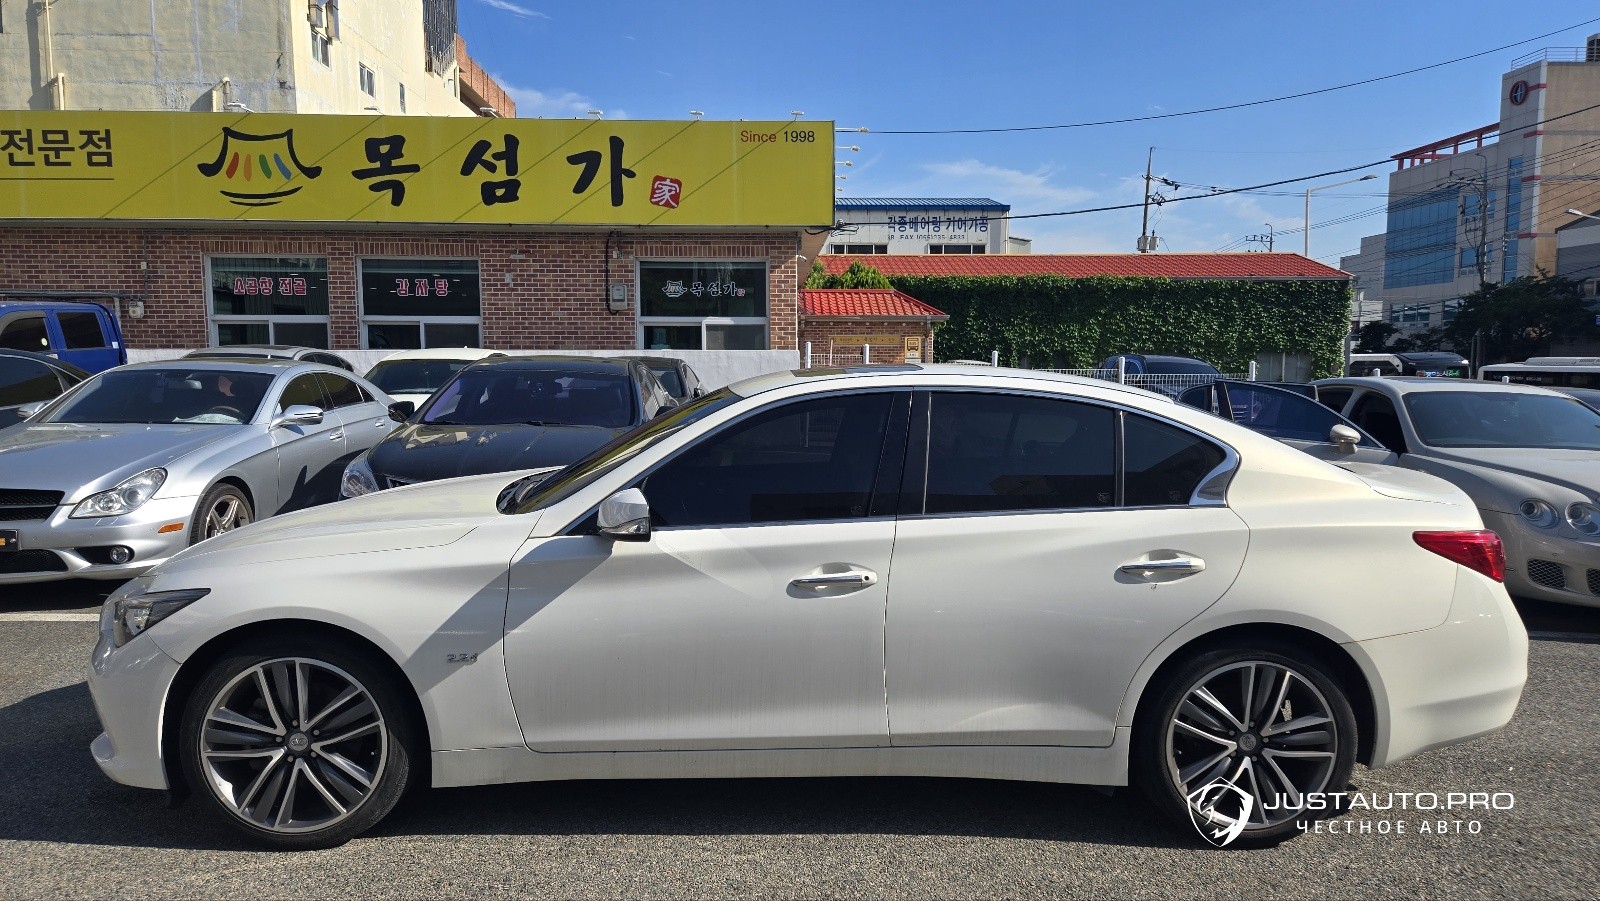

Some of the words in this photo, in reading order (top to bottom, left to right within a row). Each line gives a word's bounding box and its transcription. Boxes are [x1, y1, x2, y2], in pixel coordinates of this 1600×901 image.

[740, 130, 777, 143] Since
[783, 130, 816, 143] 1998
[0, 128, 113, 167] 전문점
[651, 177, 681, 209] 家
[279, 277, 307, 296] 전골
[395, 278, 449, 297] 감자탕
